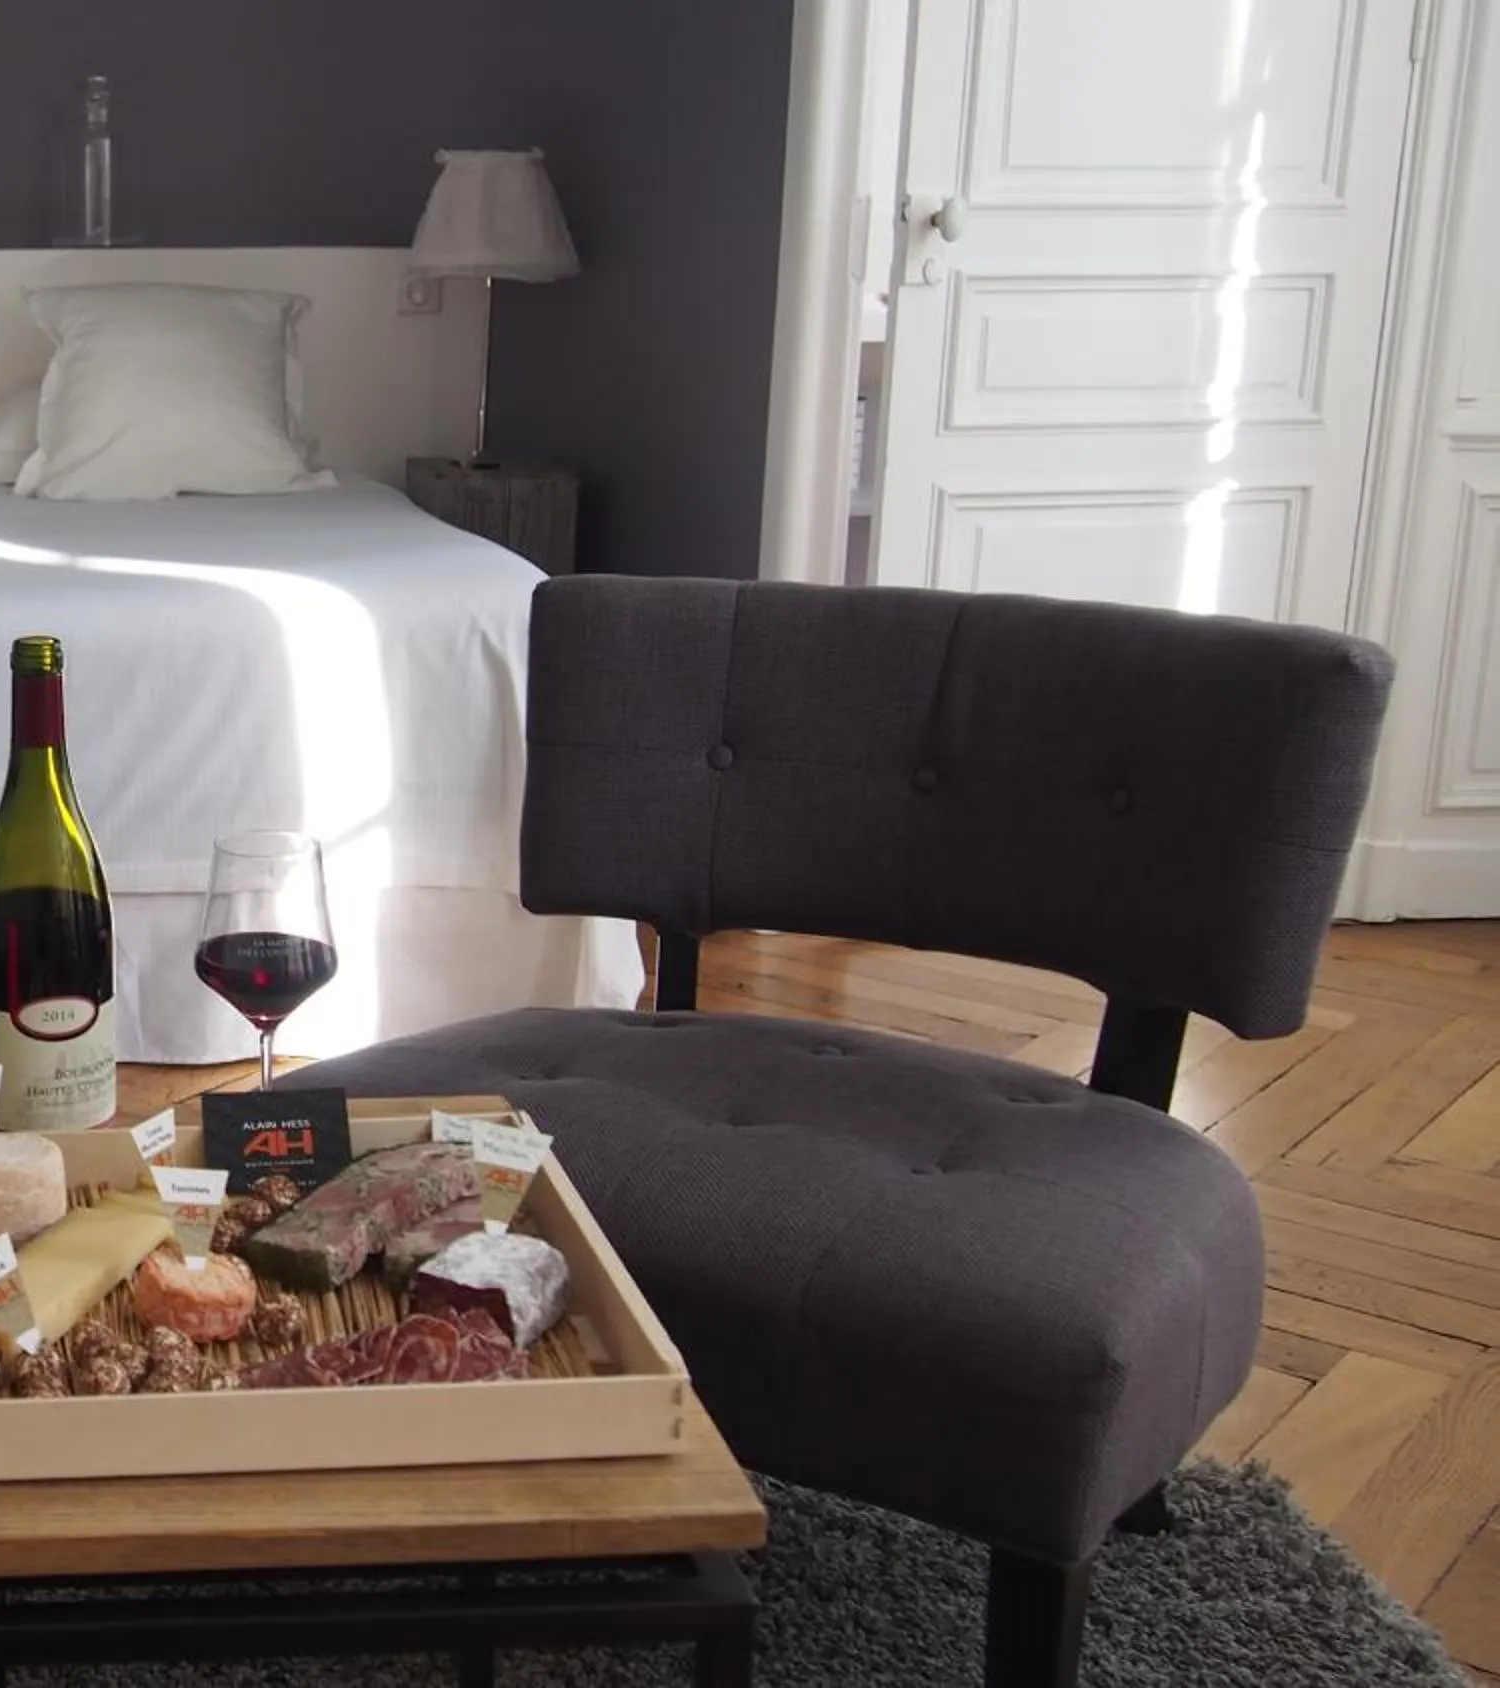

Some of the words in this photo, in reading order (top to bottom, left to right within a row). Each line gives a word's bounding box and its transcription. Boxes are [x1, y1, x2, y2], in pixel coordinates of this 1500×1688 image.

[41, 1009, 76, 1023] 2014
[243, 1121, 278, 1131] ALAIN
[281, 1119, 311, 1129] HESS
[243, 1128, 314, 1157] AH
